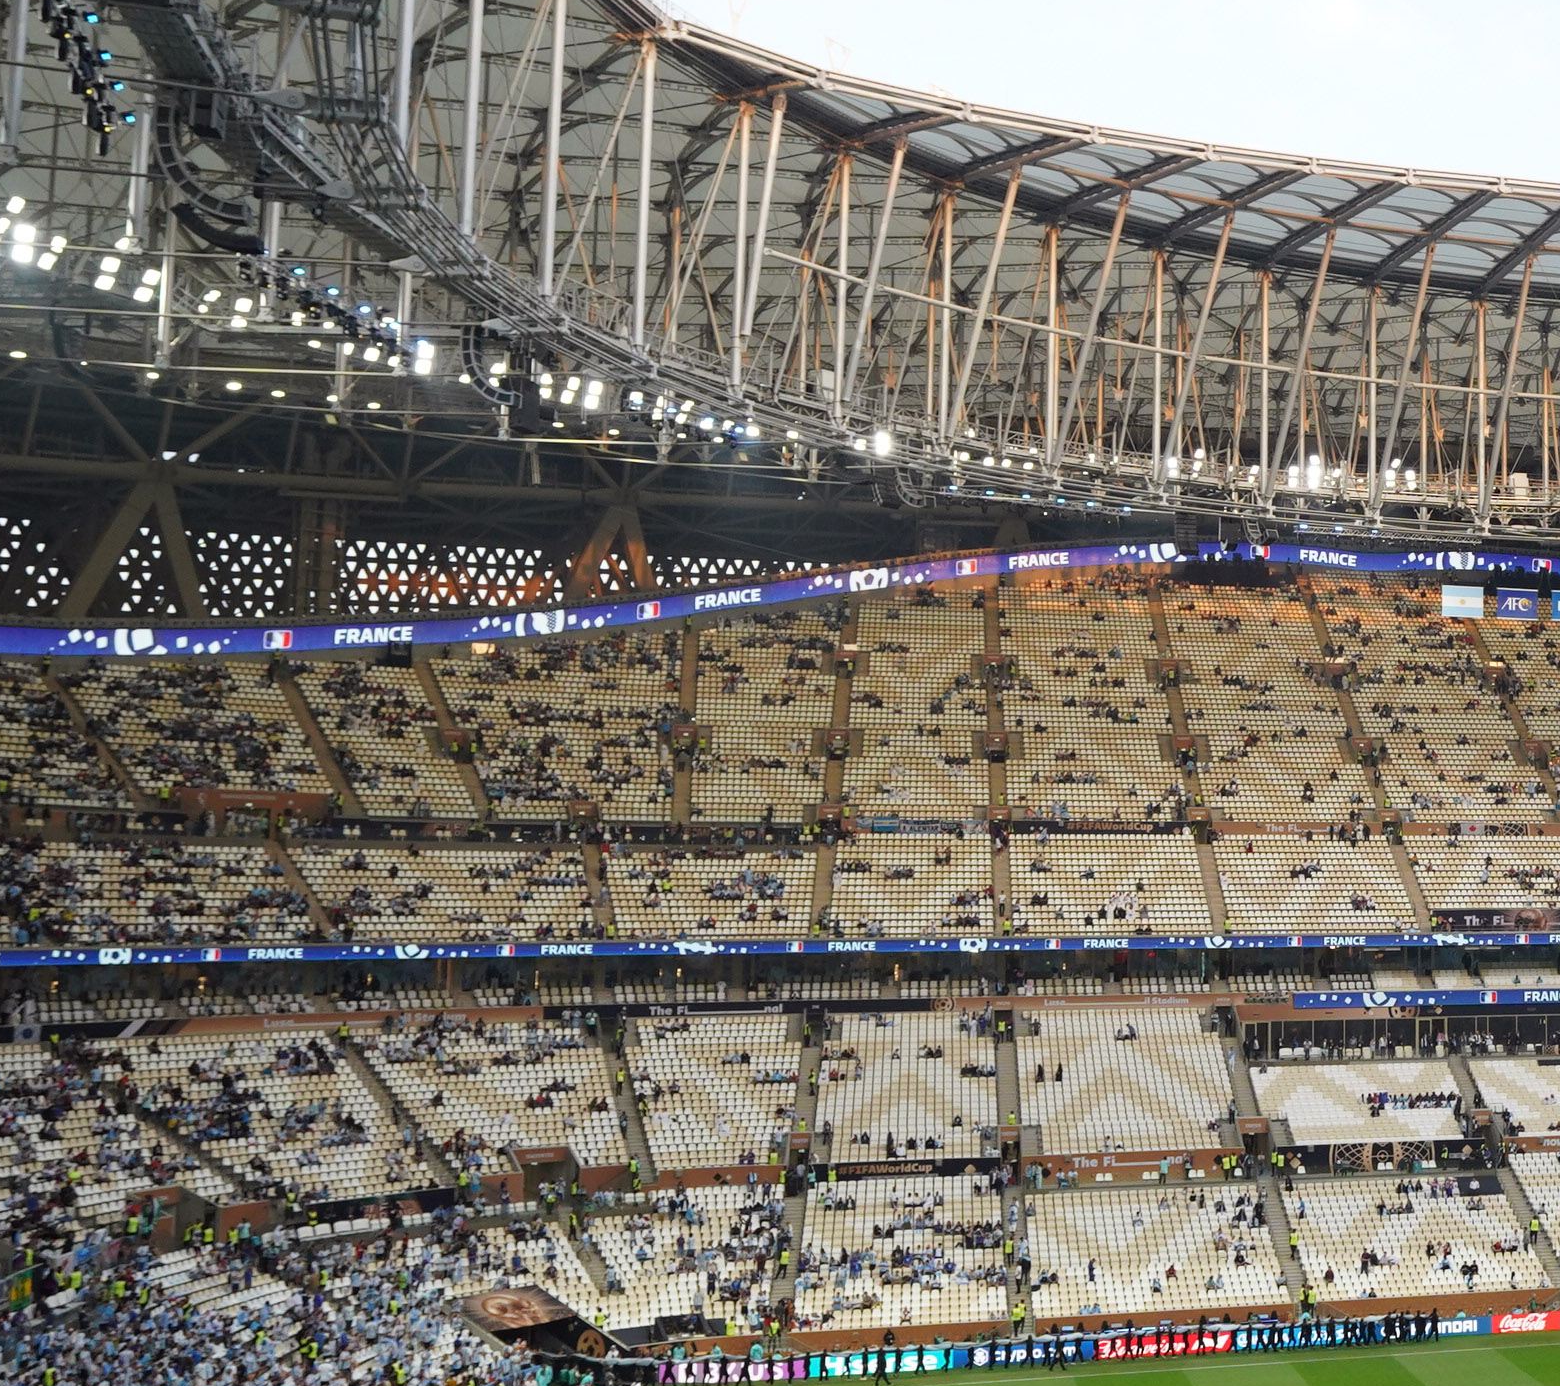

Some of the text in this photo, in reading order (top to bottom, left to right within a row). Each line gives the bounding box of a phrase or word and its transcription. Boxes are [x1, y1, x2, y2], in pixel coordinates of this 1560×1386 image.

[1009, 552, 1069, 569] FRANCE
[1300, 550, 1357, 566] FRANCE
[695, 588, 761, 609] FRANCE
[335, 626, 413, 644] FRANCE
[828, 942, 875, 951] FRANCE
[1084, 939, 1128, 948] FRANCE
[1324, 936, 1365, 946] FRANCE
[248, 948, 303, 959] FRANCE
[541, 945, 593, 954] FRANCE
[1152, 996, 1189, 1005] Stadium
[649, 1005, 674, 1016] The
[1072, 1156, 1099, 1169] The
